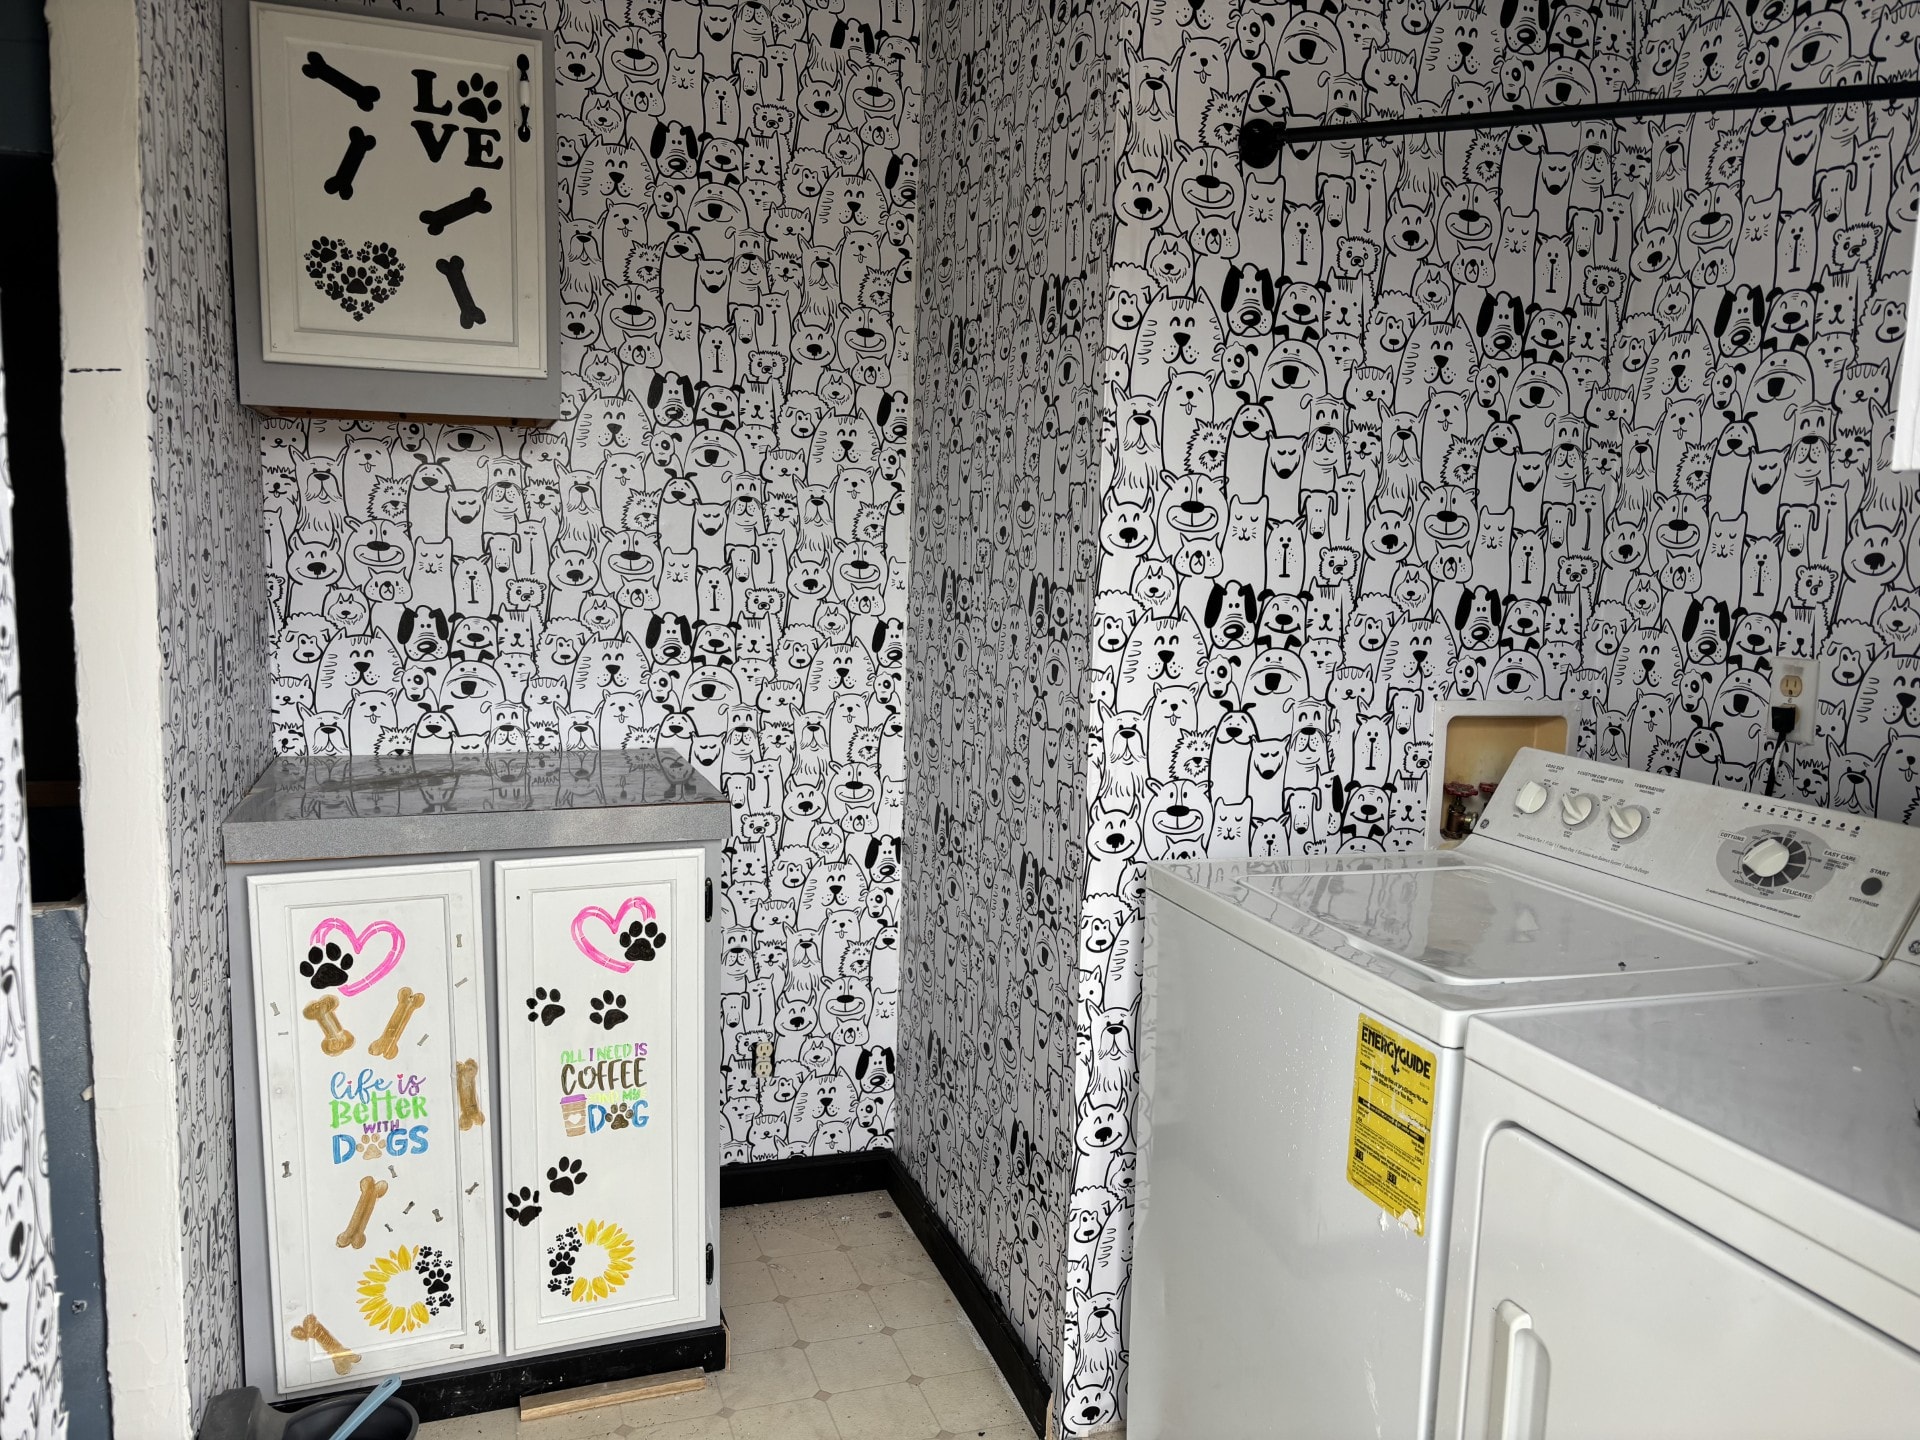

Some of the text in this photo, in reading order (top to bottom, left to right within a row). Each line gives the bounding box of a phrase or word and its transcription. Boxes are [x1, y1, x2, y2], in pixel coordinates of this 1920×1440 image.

[1720, 832, 1745, 842] COTTONS
[1824, 850, 1857, 862] EASY CARE
[1869, 867, 1890, 877] START
[1782, 887, 1813, 900] DELICATES
[589, 1047, 594, 1061] I
[596, 1043, 633, 1061] NEED
[634, 1042, 648, 1057] IS
[1361, 1025, 1432, 1080] ENERGYGUIDE
[561, 1057, 648, 1095] COFFEE
[396, 1073, 427, 1096] is
[363, 1119, 400, 1134] WITH
